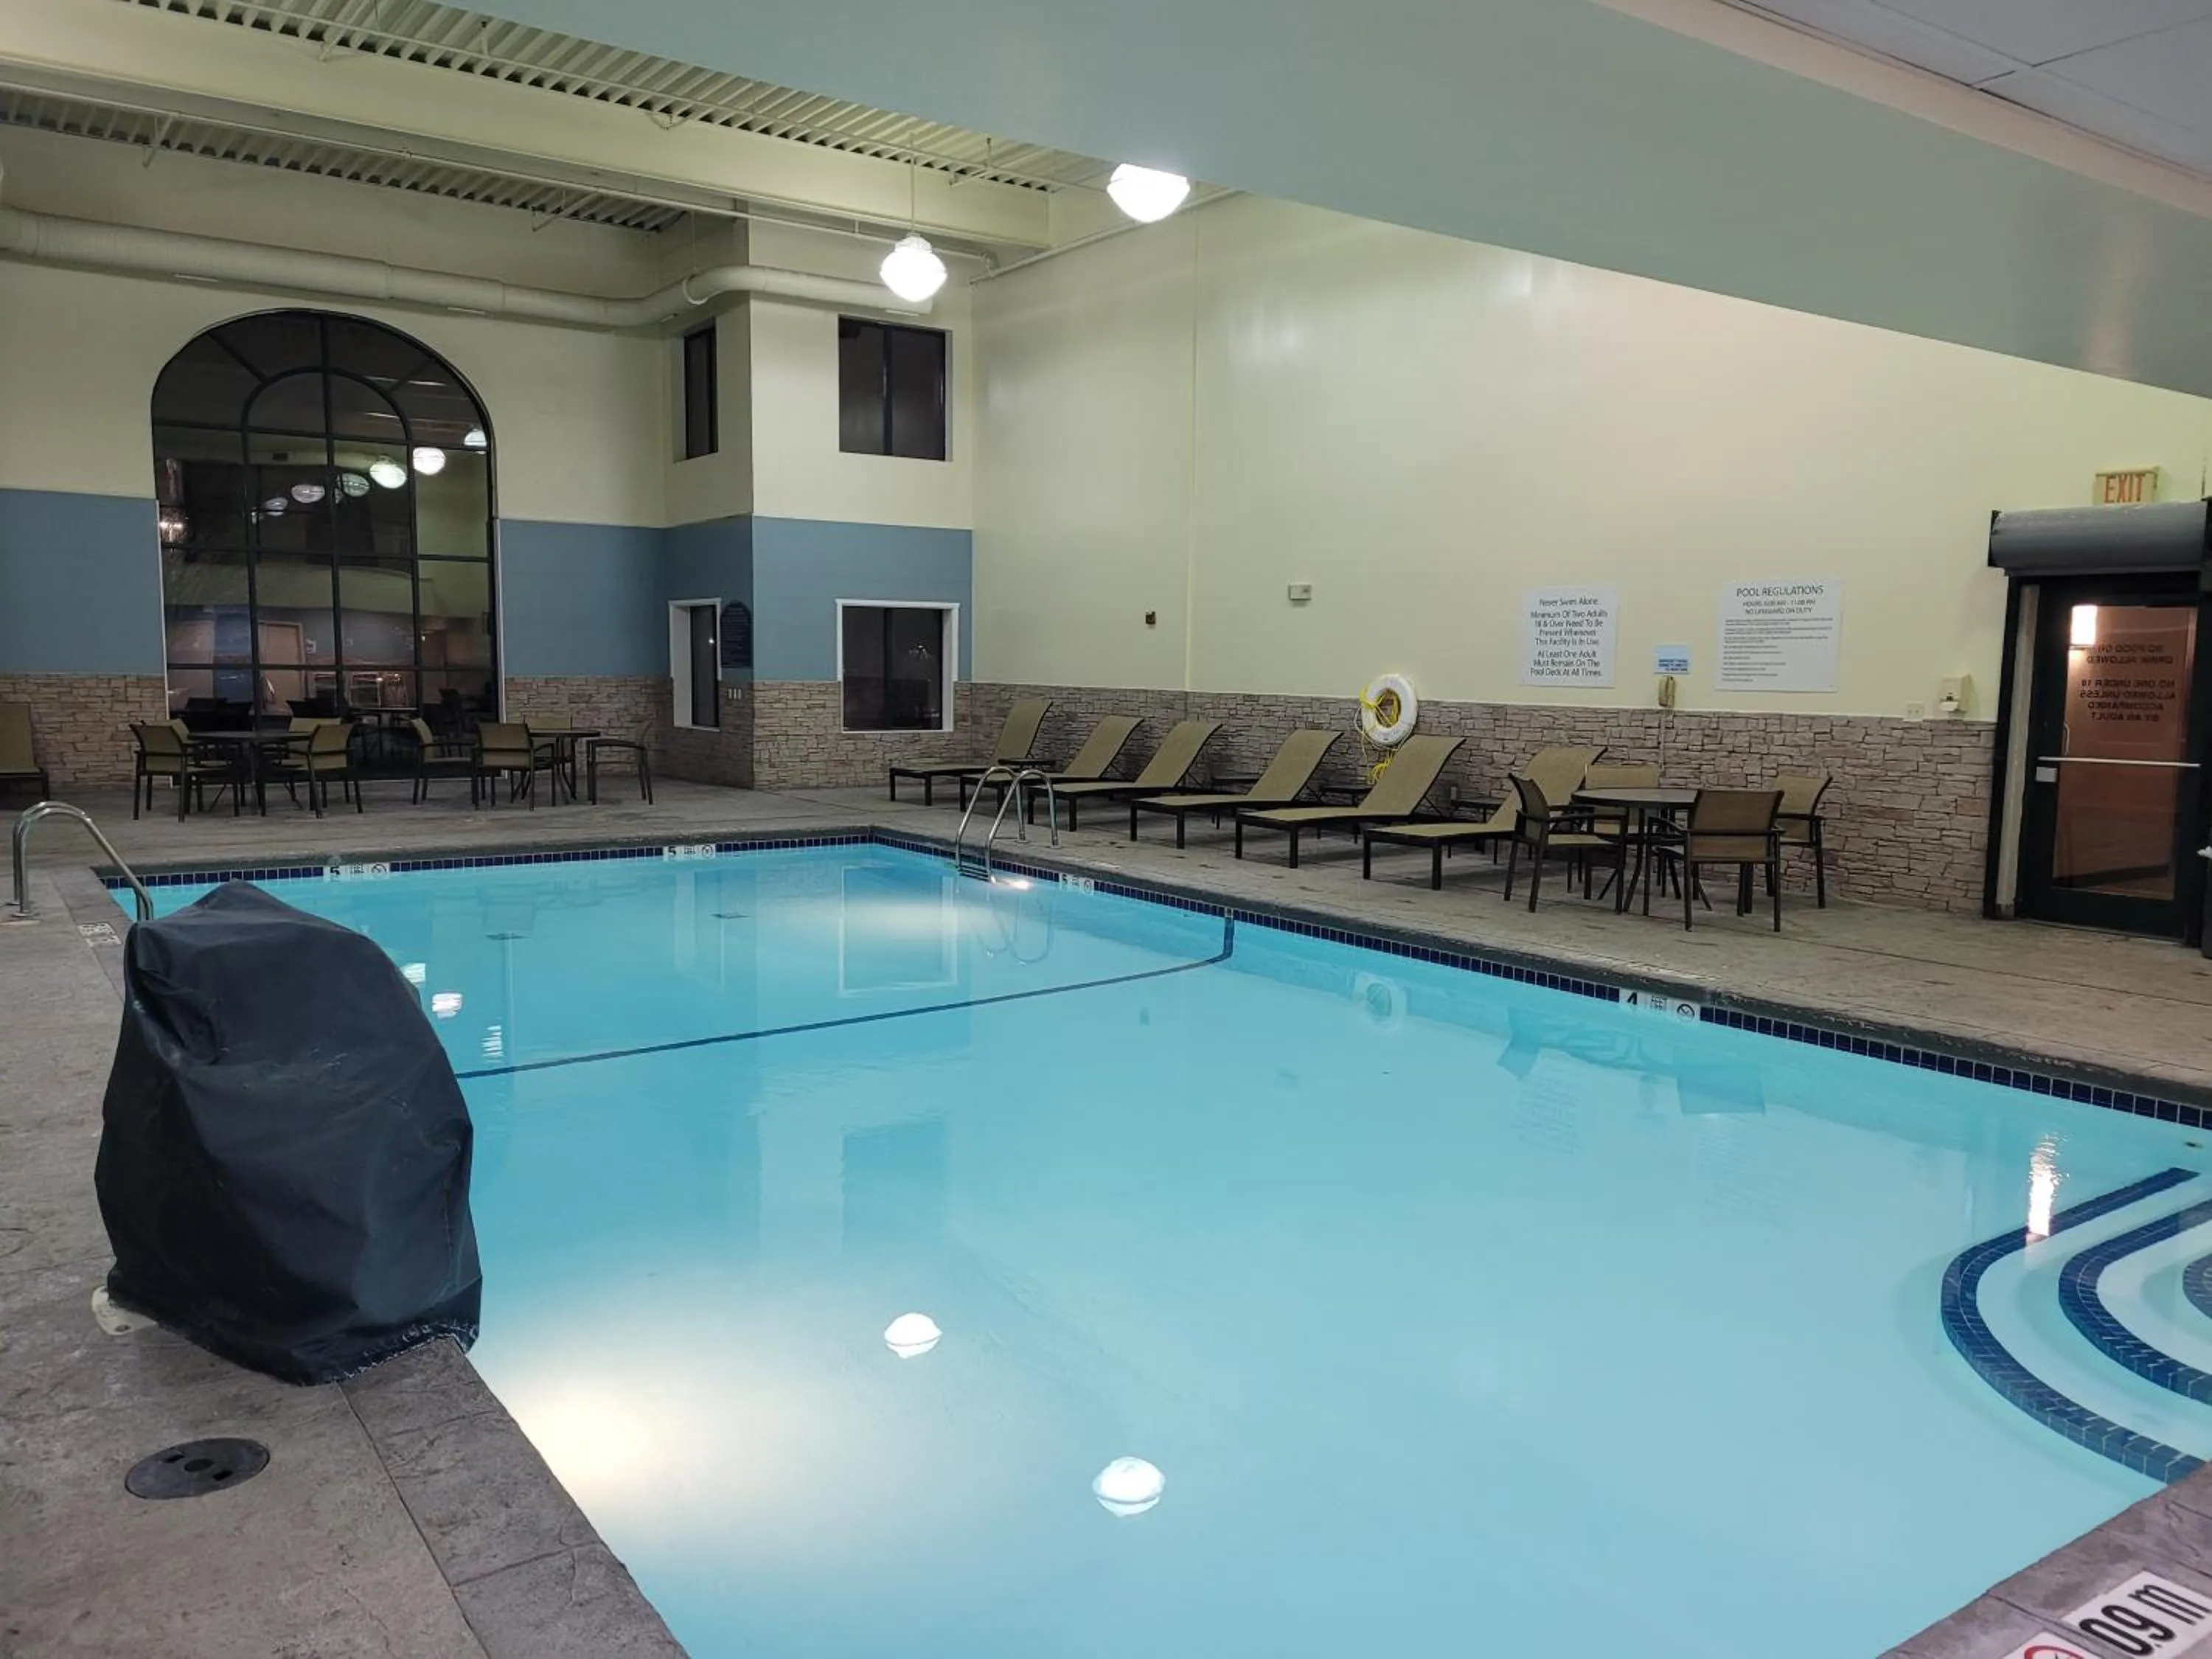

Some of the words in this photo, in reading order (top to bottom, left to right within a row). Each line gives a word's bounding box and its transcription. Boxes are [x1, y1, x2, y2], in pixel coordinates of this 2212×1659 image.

[2104, 473, 2145, 503] EXIT
[1736, 588, 1760, 597] POOL
[1761, 585, 1823, 596] REGULATIONS
[2127, 1585, 2212, 1626] m
